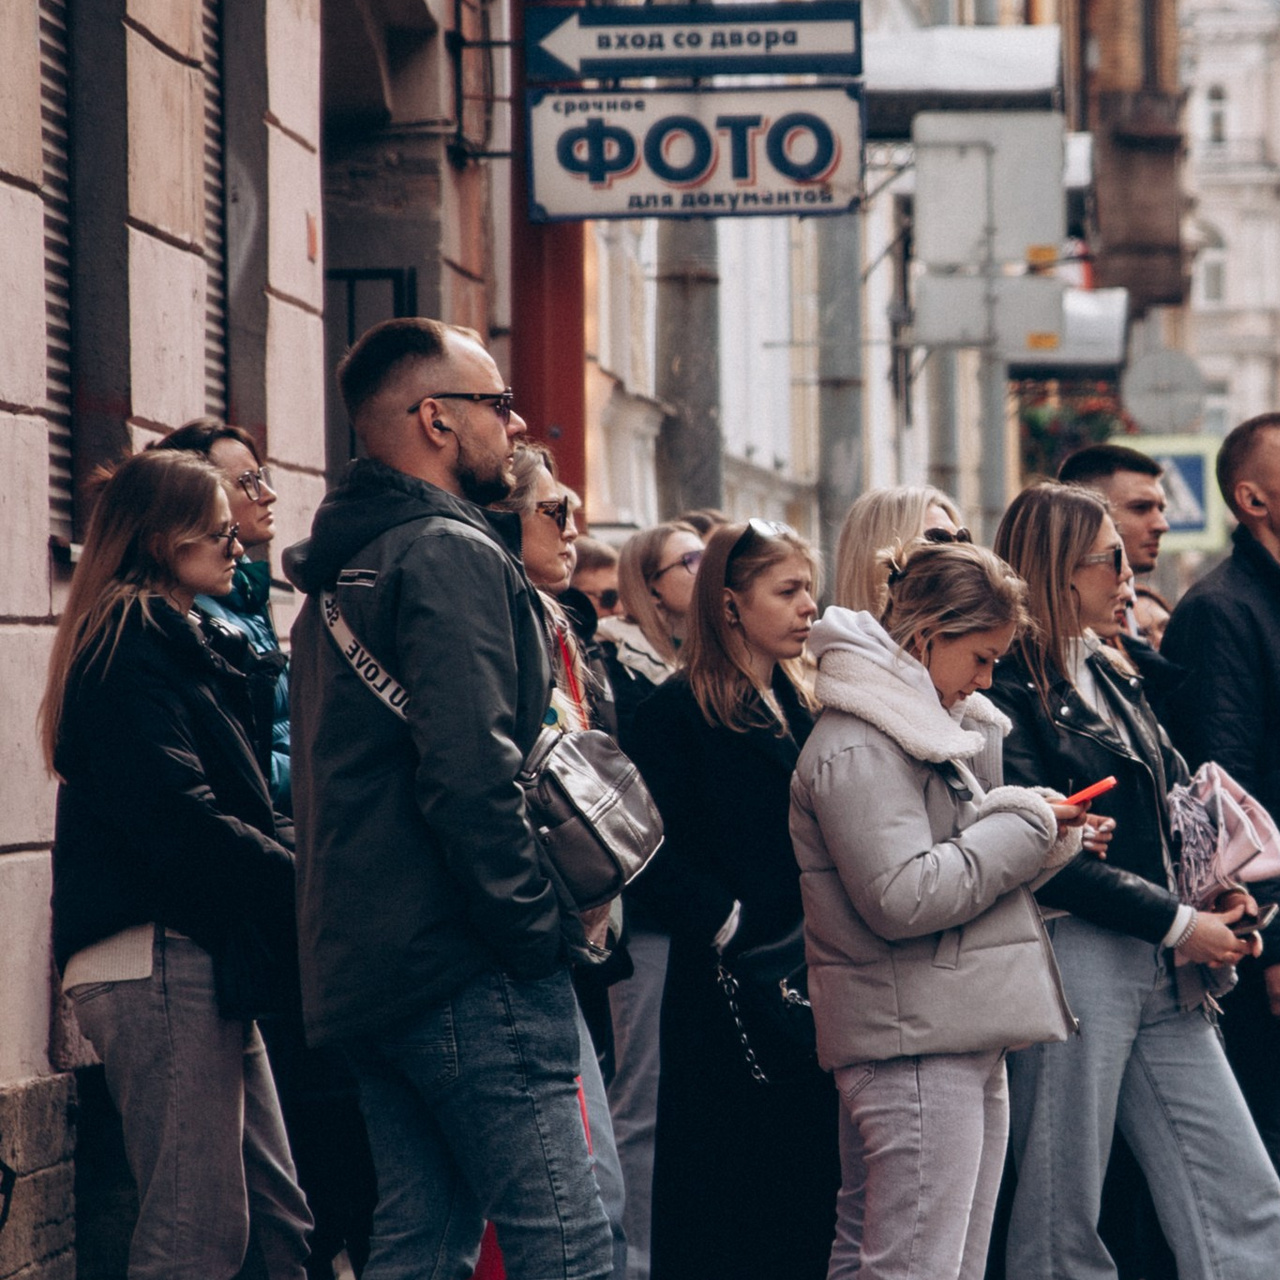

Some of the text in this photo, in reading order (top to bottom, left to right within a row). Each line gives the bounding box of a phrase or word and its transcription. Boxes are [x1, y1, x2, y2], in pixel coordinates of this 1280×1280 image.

[597, 29, 798, 54] вход со двора
[552, 98, 647, 116] срочное
[556, 111, 840, 188] ФОТО
[627, 186, 834, 212] для документов
